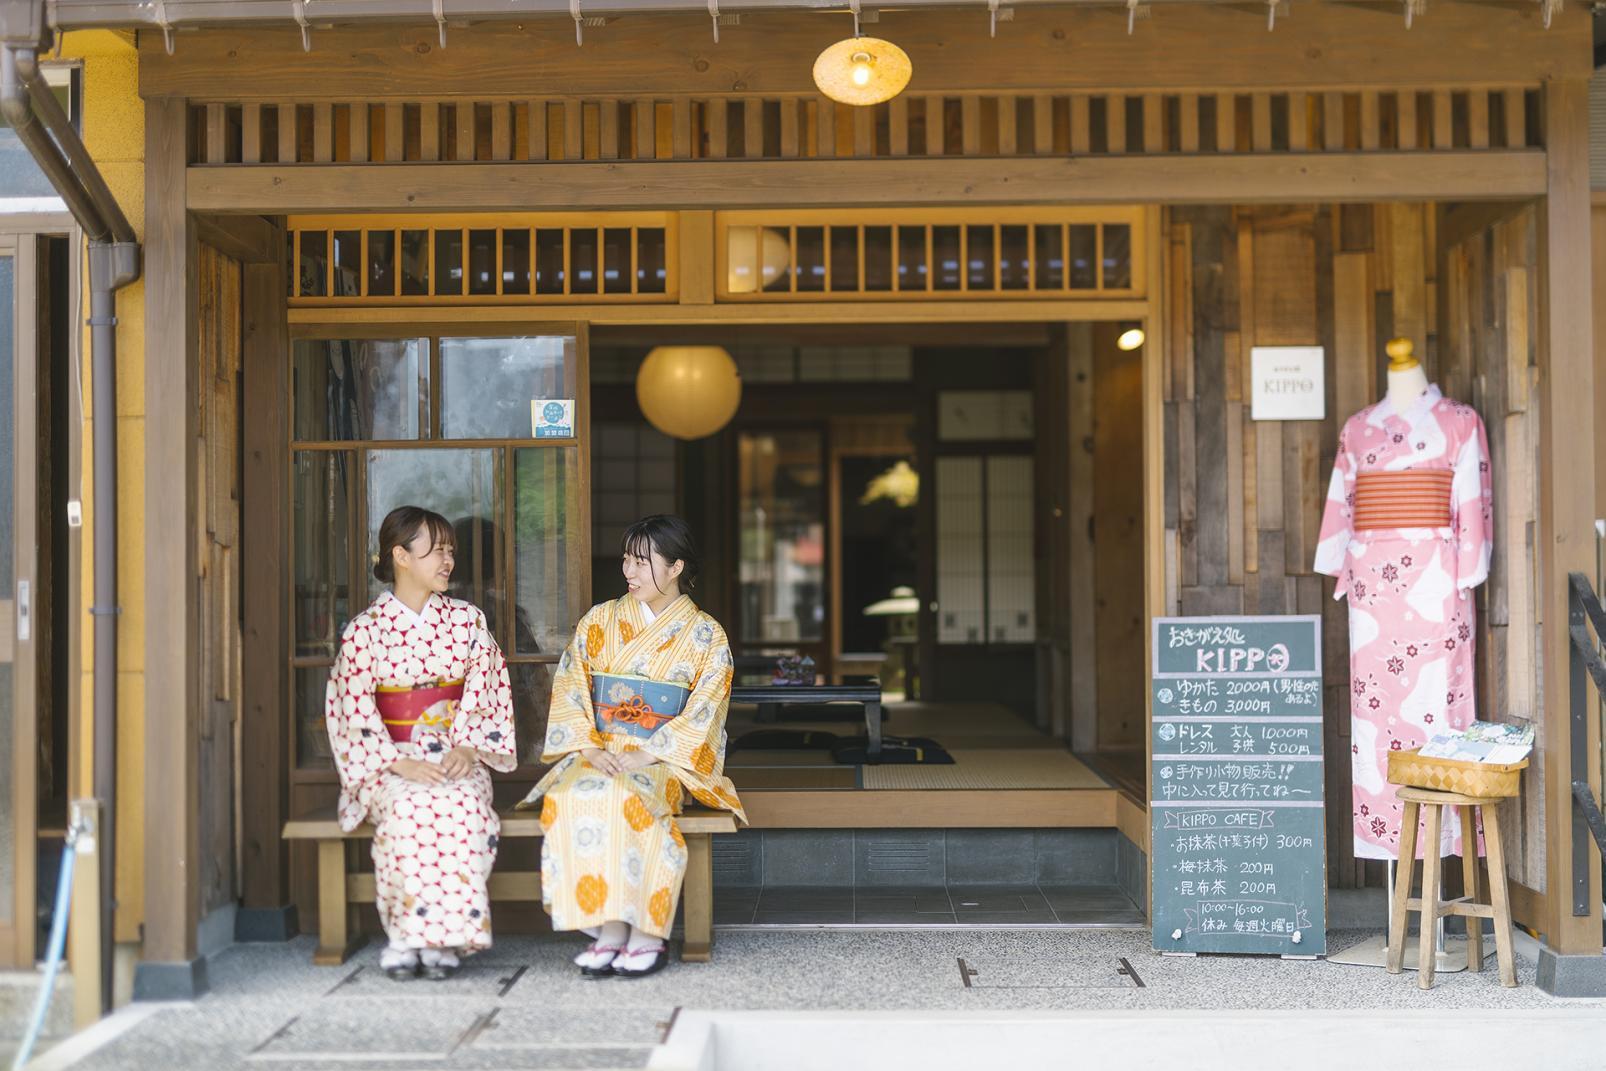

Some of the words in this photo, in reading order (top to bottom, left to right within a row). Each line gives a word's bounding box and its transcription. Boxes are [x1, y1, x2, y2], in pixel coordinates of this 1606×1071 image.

[1169, 626, 1246, 648] おきがえ処
[1196, 643, 1290, 673] KIPPO
[1177, 679, 1219, 697] ゆかた
[1179, 700, 1217, 714] きもの
[1178, 724, 1213, 739] ドレス
[1230, 724, 1252, 738] 大人
[1179, 741, 1218, 754] レンタル
[1232, 739, 1255, 753] 子供
[1268, 742, 1310, 755] 500円
[1182, 813, 1217, 827] KIPPO
[1224, 813, 1258, 826] CAFE
[1276, 834, 1313, 849] 300円
[1239, 863, 1274, 875] 200円
[1239, 881, 1276, 895] 200円
[1201, 917, 1228, 932] 休み
[1233, 918, 1294, 933] 毎週火曜日
